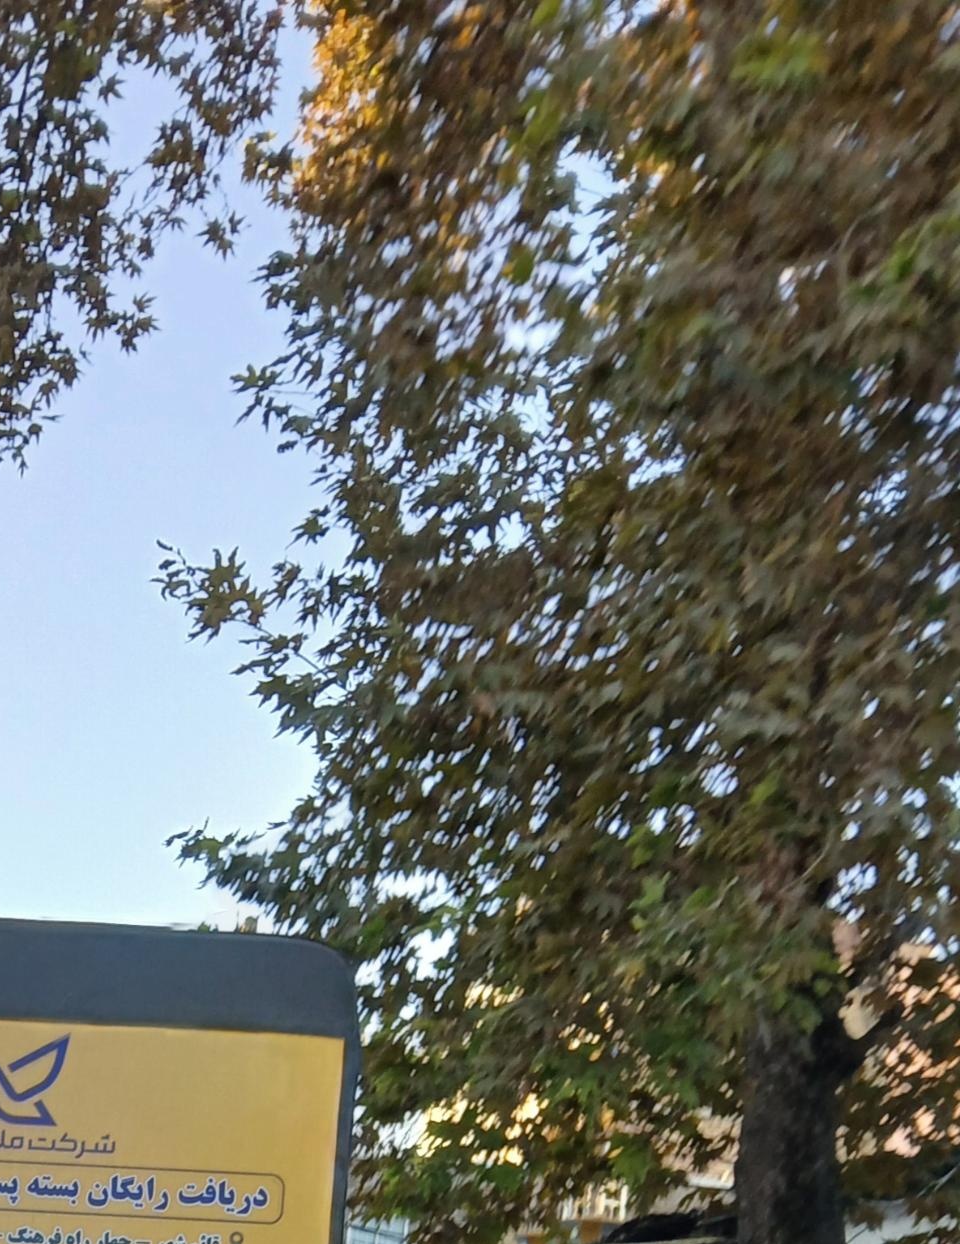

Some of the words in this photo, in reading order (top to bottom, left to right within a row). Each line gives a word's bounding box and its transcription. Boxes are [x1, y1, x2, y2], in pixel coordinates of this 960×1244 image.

[28, 1132, 116, 1159] شرکت
[27, 1175, 79, 1205] بسته
[87, 1173, 169, 1210] رایگان
[178, 1176, 269, 1214] دریافت
